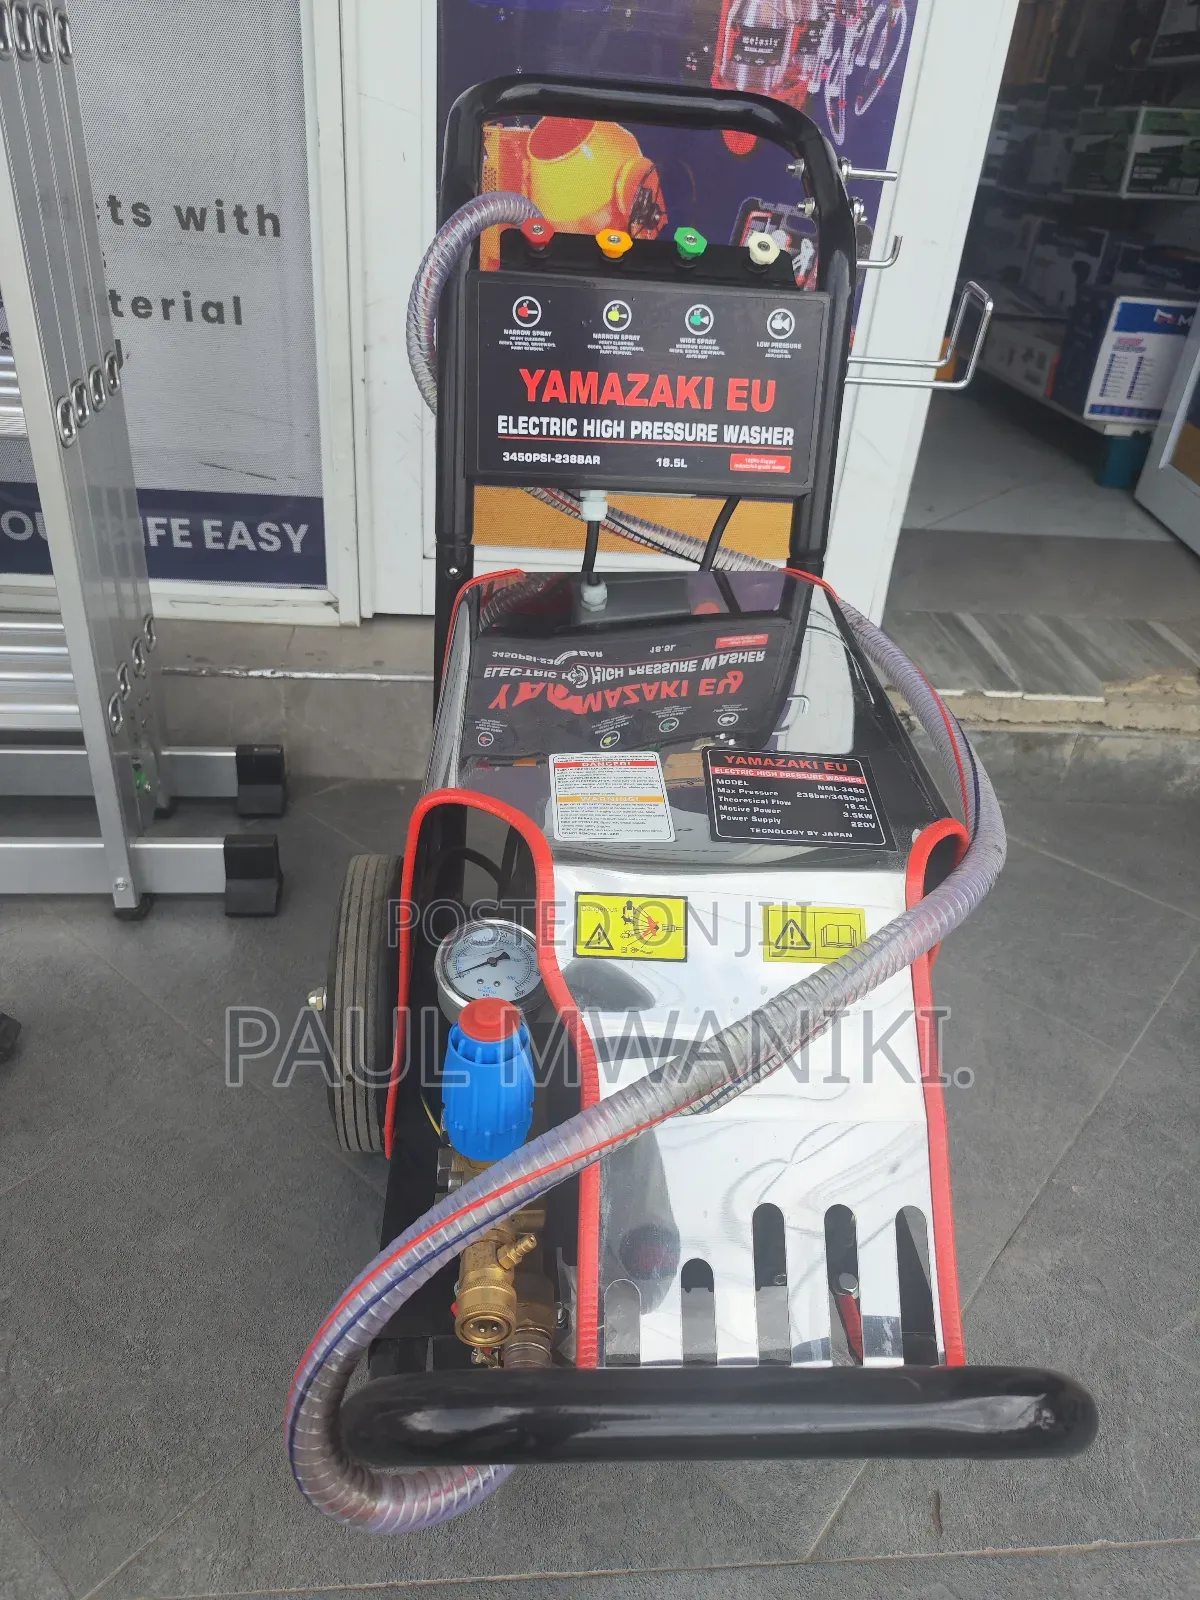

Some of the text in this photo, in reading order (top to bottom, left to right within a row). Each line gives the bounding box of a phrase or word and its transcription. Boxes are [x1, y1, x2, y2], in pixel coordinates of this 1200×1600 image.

[174, 199, 281, 237] with
[108, 289, 243, 325] terial
[503, 328, 531, 336] NARROW
[771, 342, 802, 350] PRESSURE
[519, 368, 776, 412] YAMAZAKI EU
[497, 415, 794, 446] ELECTRIC HIGH PRESSURE WASHER
[502, 452, 688, 468] 3450PSI-238BAR 18.5L
[139, 516, 193, 549] FE
[203, 520, 309, 553] EASY
[723, 755, 848, 772] YAMAZAKI EU
[714, 767, 754, 777] ELECTRIC
[780, 771, 824, 780] PRESSURE
[826, 774, 862, 784] WASHER
[716, 778, 865, 794] MODEL NML-3450
[738, 788, 779, 796] Pressure
[718, 796, 871, 811] Theoretical Flow 18.5L
[719, 804, 750, 813] Motive
[720, 814, 876, 829] Power Supply 220V
